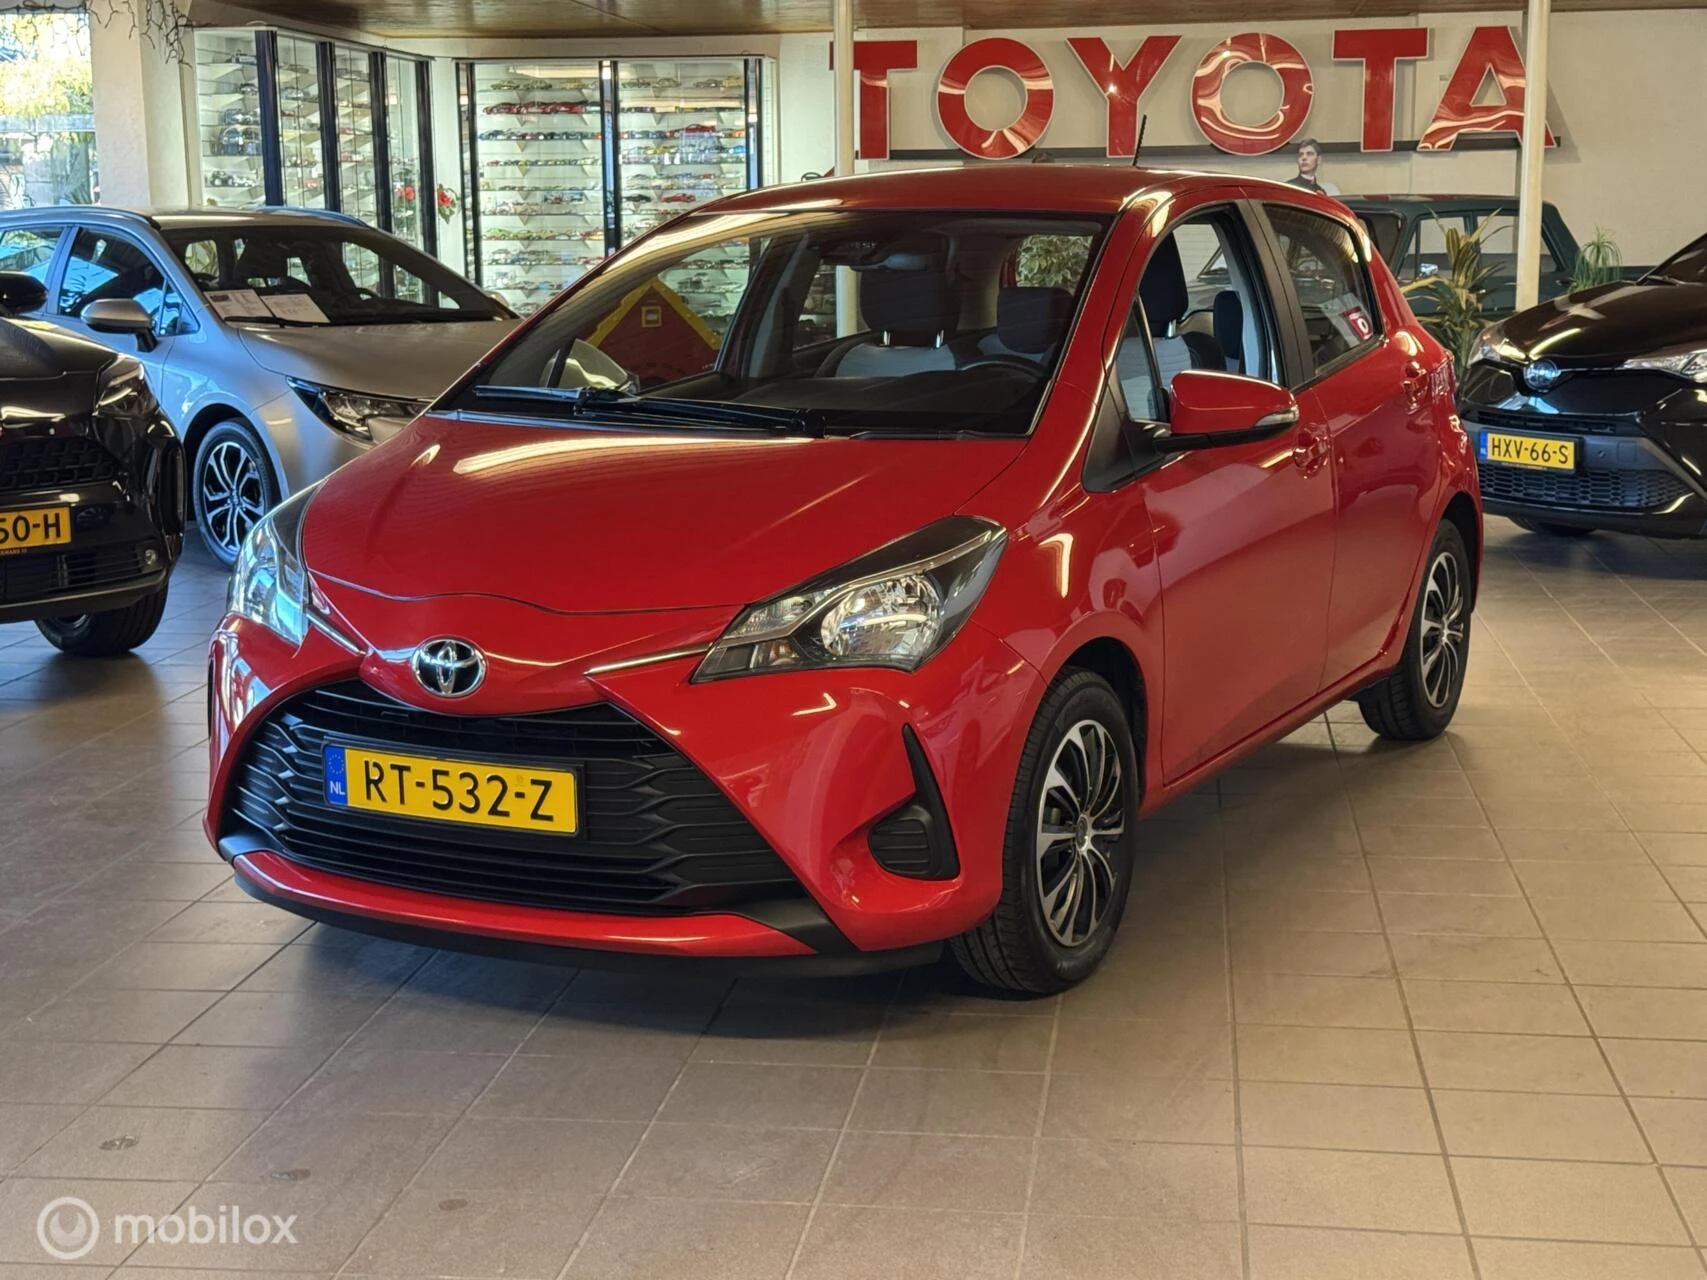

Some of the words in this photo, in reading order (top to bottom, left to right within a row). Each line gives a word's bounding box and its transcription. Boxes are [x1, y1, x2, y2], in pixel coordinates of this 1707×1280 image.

[829, 26, 1556, 160] TOYOTA
[1491, 437, 1568, 464] HXV-66-S
[330, 780, 345, 796] NL
[364, 760, 554, 821] RT-532-Z
